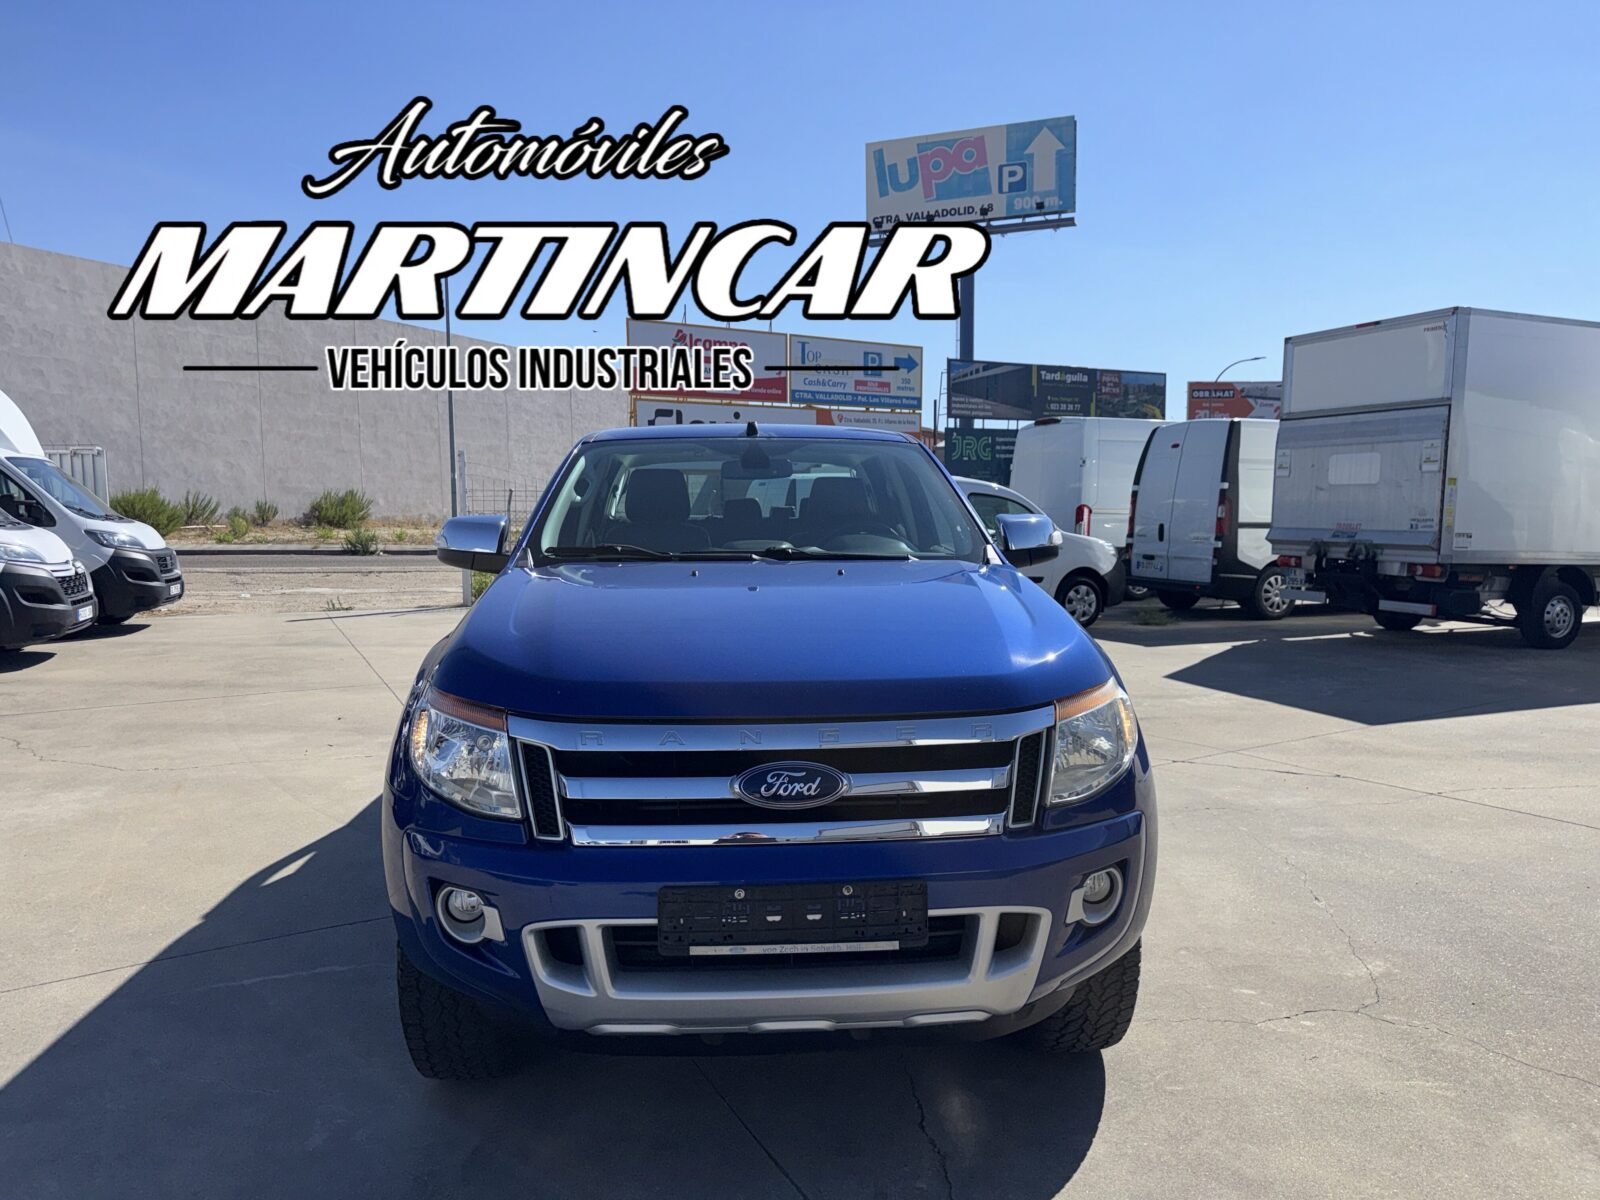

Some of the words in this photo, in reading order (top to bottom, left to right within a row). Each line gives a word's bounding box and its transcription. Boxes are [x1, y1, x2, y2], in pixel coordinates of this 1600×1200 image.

[872, 135, 987, 200] lupa
[803, 377, 848, 390] Cash&Carry
[579, 722, 993, 746] RANGER
[760, 770, 821, 798] Ford
